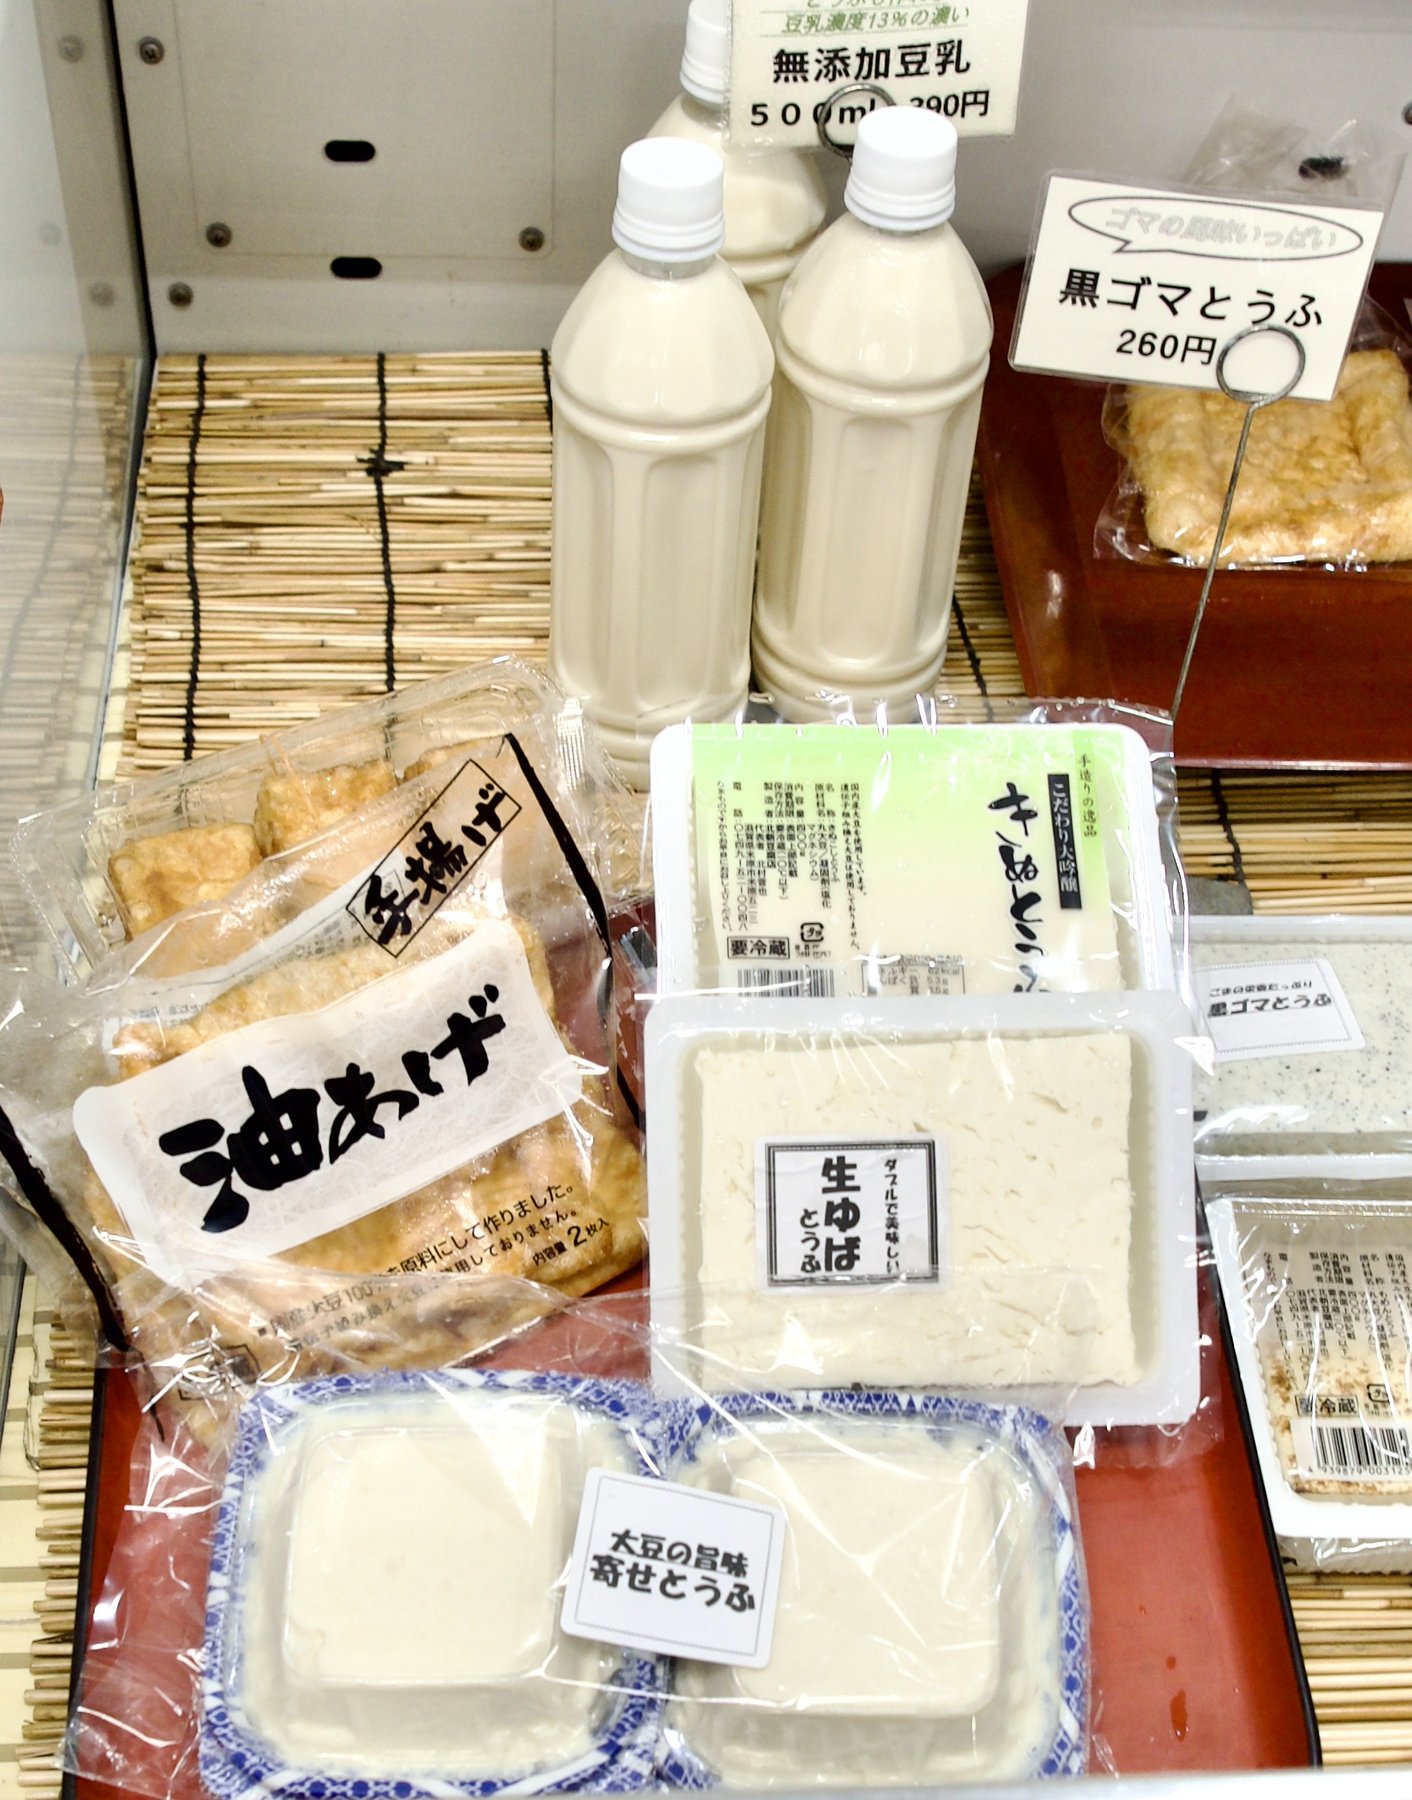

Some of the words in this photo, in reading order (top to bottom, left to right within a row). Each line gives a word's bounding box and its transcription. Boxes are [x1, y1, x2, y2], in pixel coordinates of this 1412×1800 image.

[772, 39, 971, 84] 無添加豆乳
[1058, 268, 1323, 328] 黒ゴマとうふ
[1116, 329, 1217, 365] 260円
[1078, 754, 1098, 838] 手造りの逸品
[730, 938, 788, 957] 要冷蔵
[1207, 992, 1332, 1018] 黒ゴマとうふ
[158, 983, 507, 1233] 油あげ
[799, 1208, 822, 1273] とうふ
[821, 1155, 861, 1272] 生ゆば
[532, 1240, 568, 1267] 内容量
[567, 1216, 610, 1248] 2枚入
[609, 1528, 750, 1579] 大豆の旨味
[590, 1553, 756, 1613] 寄せとうふ
